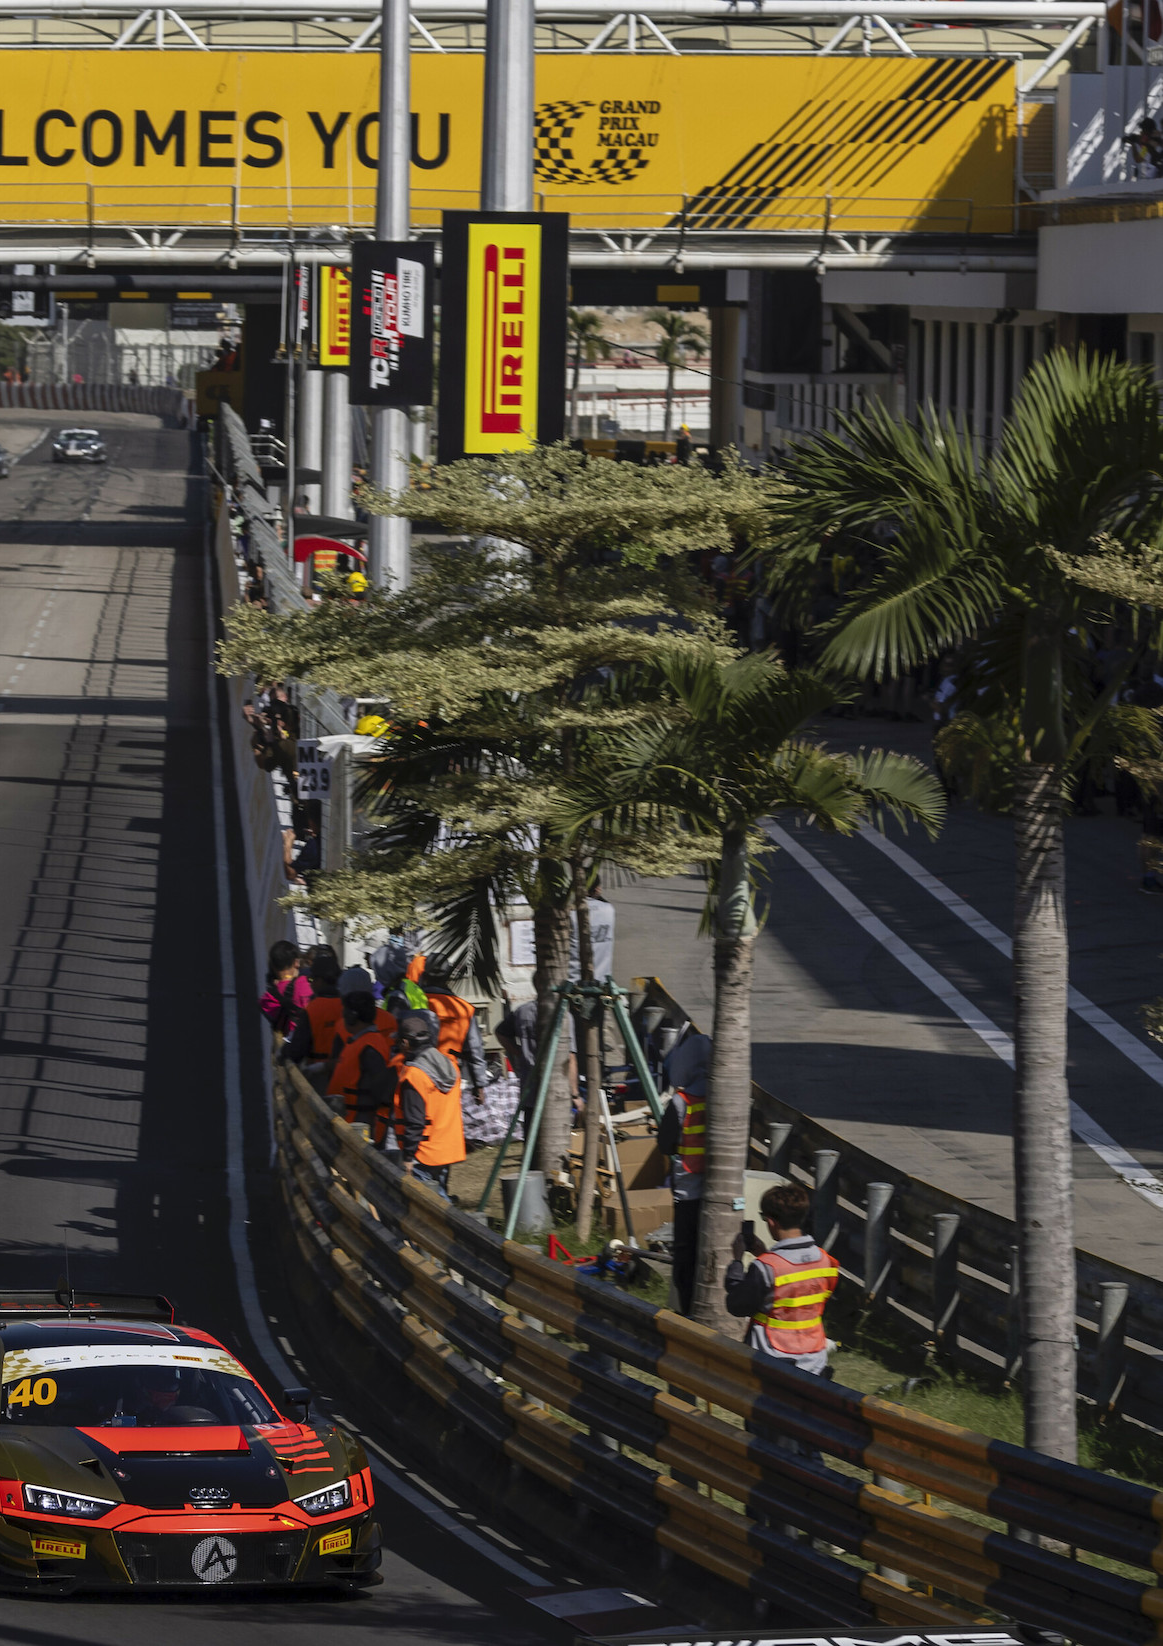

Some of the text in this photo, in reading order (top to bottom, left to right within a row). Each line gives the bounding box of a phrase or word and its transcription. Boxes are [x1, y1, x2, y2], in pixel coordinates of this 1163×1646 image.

[597, 100, 662, 115] GRAND
[597, 116, 641, 131] PRIX
[596, 132, 660, 147] MACAU
[402, 269, 413, 327] KUMHO TIRE
[481, 243, 526, 434] PIRELLI
[369, 338, 390, 389] TCR
[7, 1377, 58, 1408] 40
[36, 1538, 82, 1555] PIRELLI
[323, 1532, 350, 1551] PIRELLI
